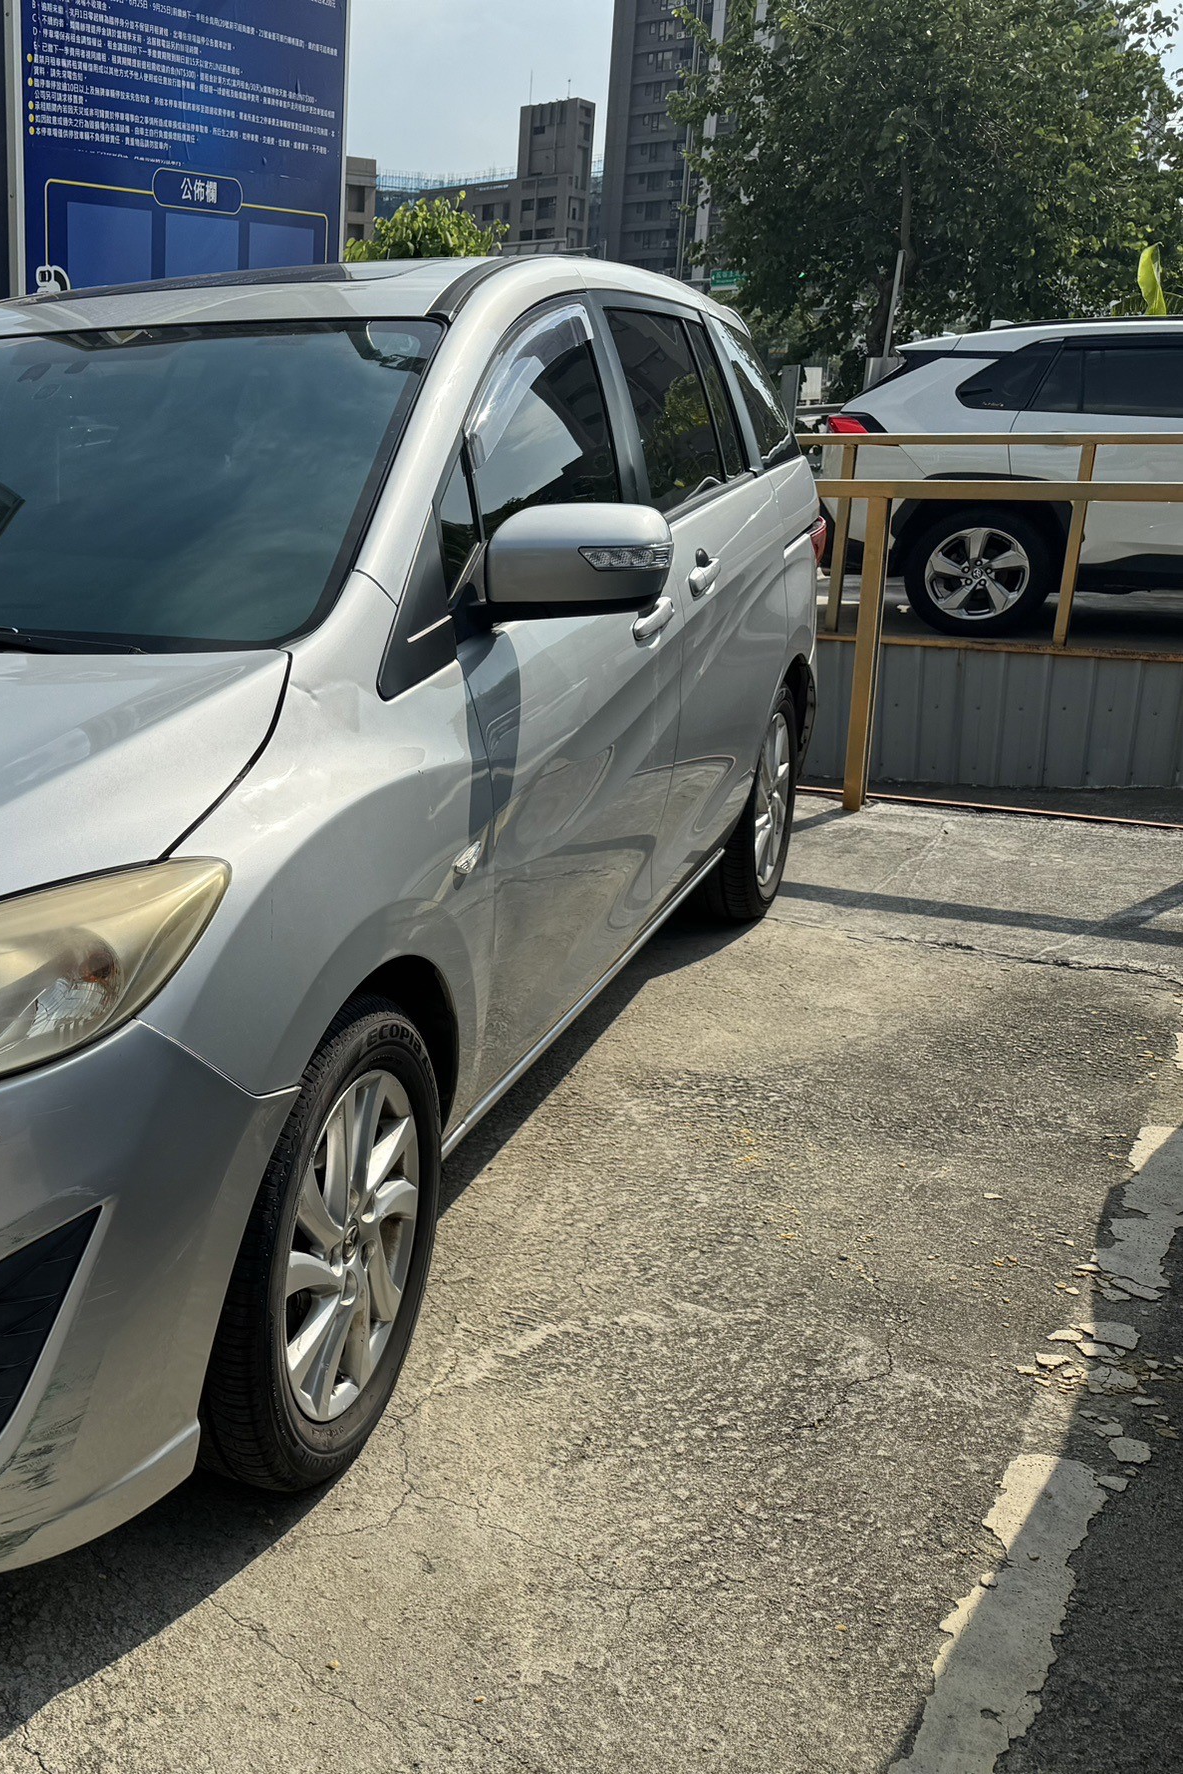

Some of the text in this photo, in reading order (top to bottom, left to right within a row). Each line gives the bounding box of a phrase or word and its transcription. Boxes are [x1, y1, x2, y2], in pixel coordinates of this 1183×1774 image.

[180, 177, 218, 205] 公佈欄
[366, 1024, 422, 1056] ECOPIA
